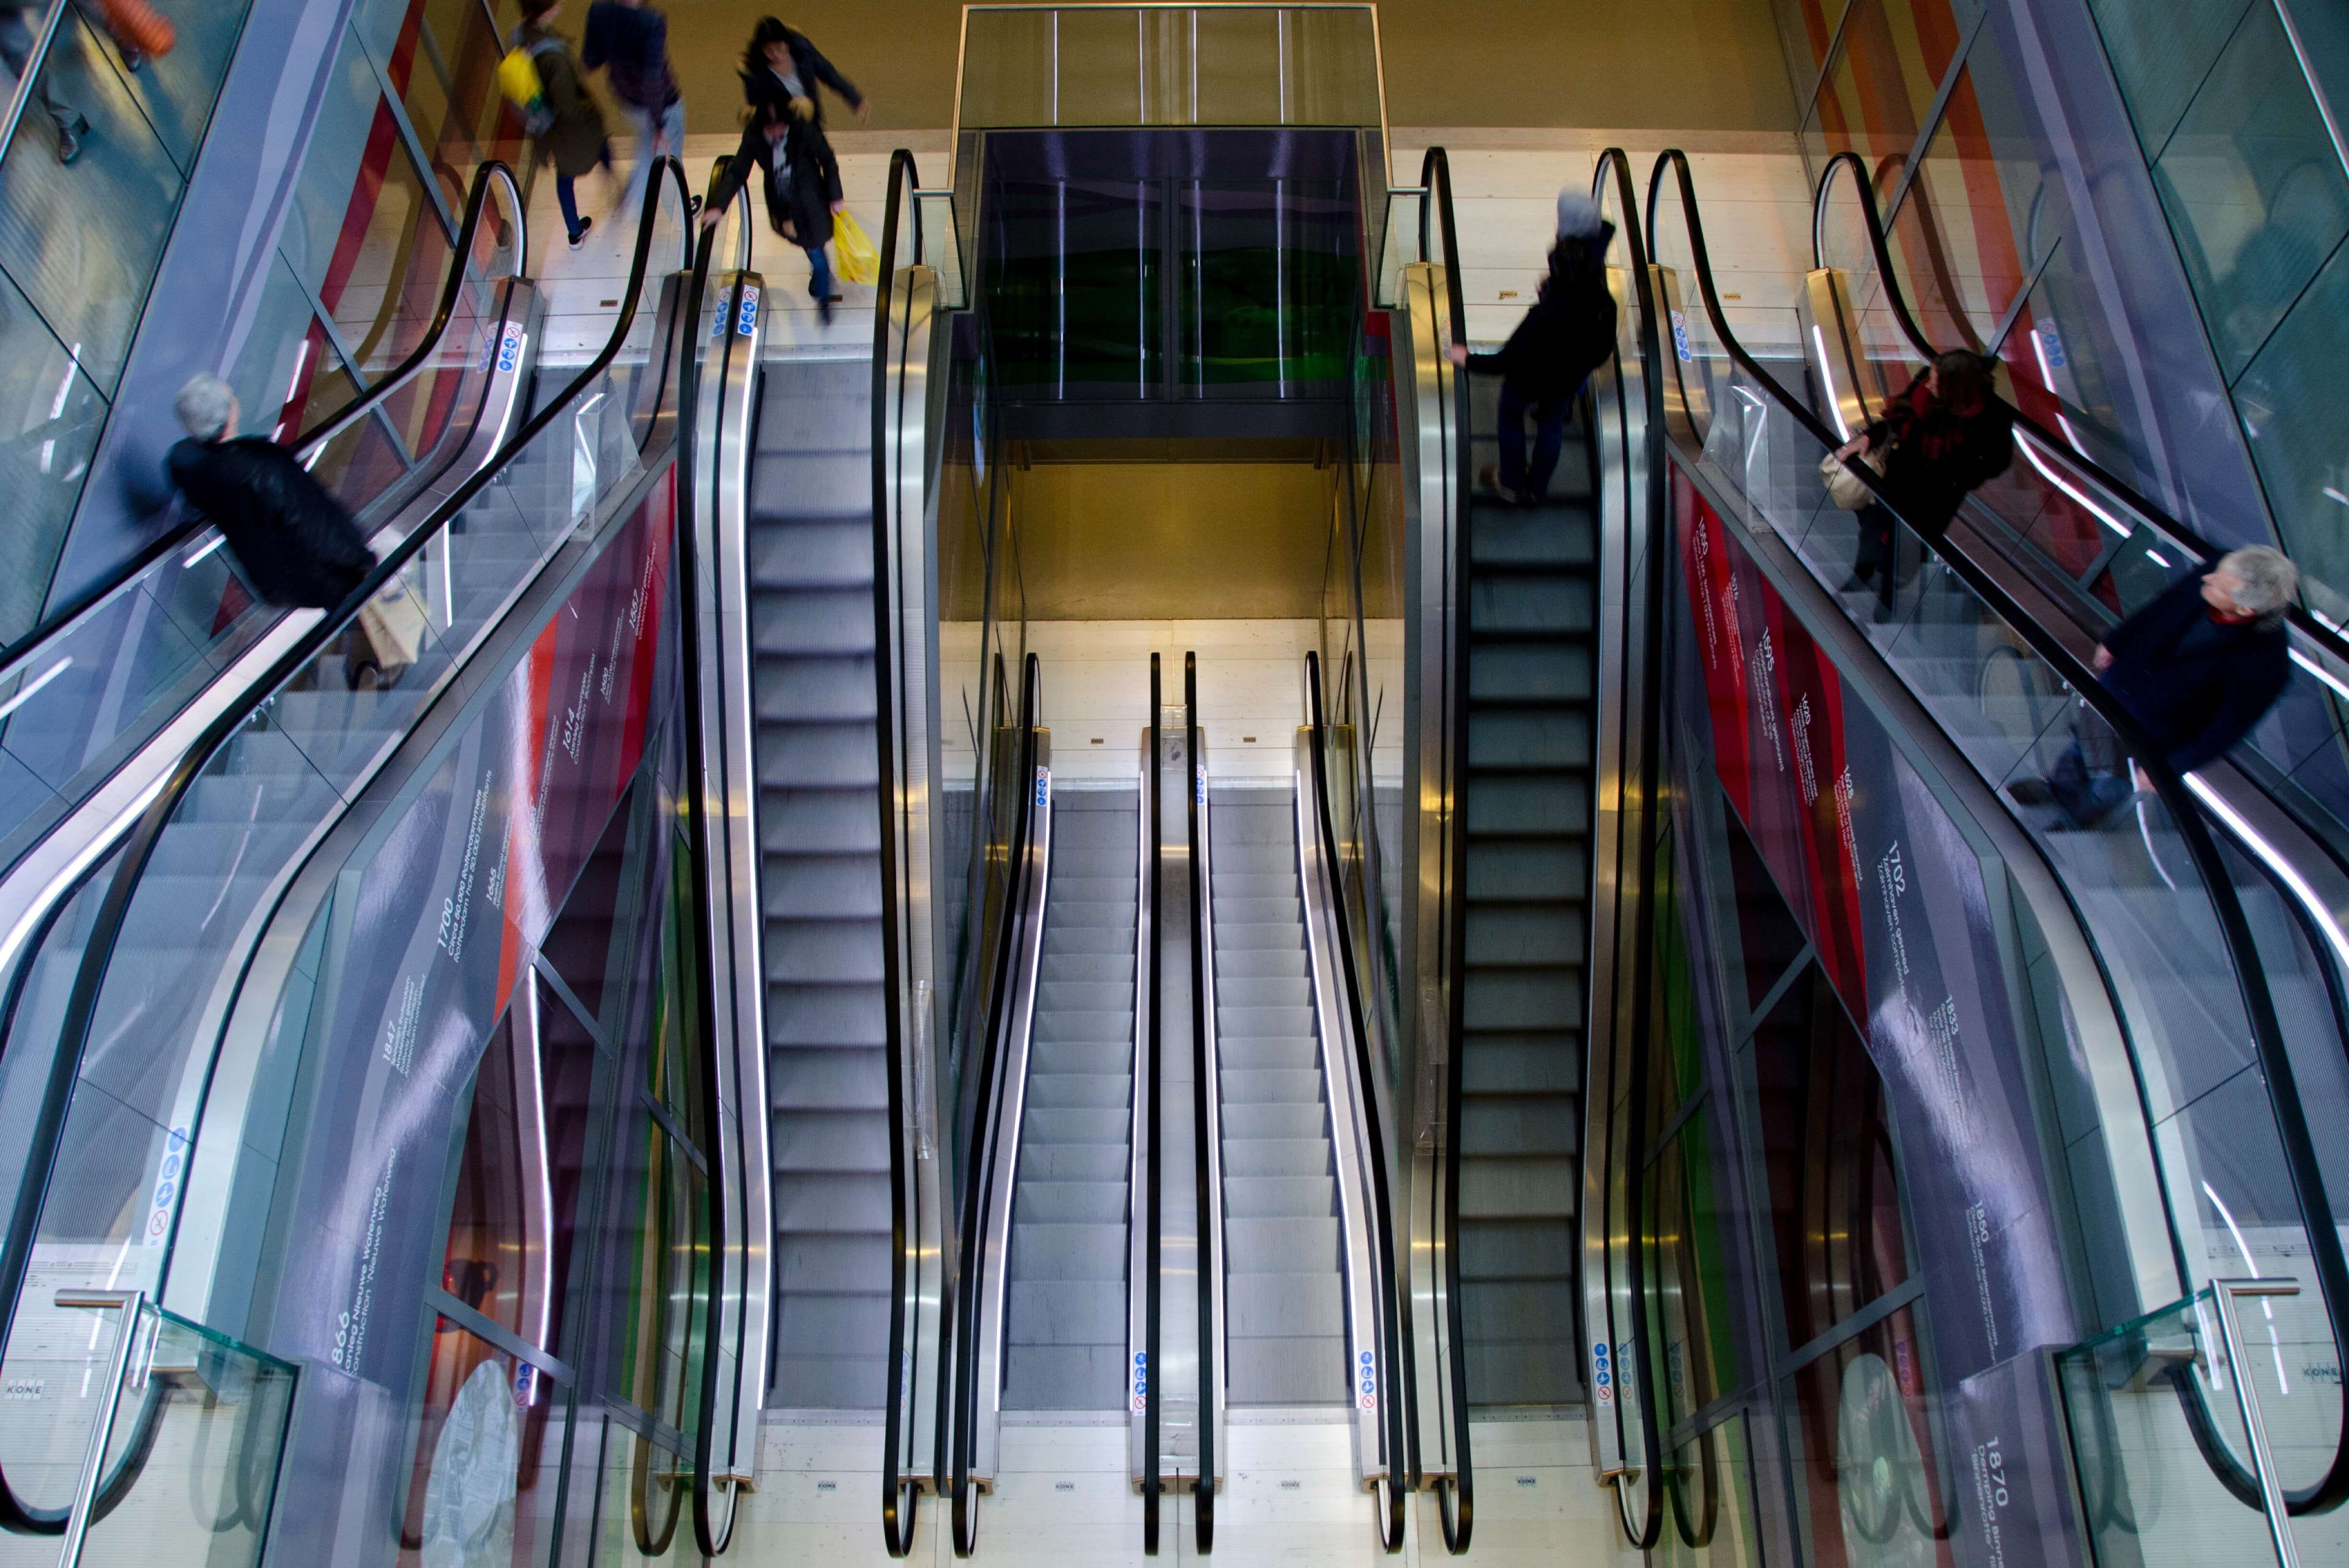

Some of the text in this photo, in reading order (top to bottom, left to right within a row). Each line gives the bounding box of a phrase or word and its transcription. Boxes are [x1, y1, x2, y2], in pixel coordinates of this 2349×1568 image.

[1698, 516, 1709, 555] 1550
[629, 587, 640, 628] 1557
[1761, 626, 1775, 671] 1595
[563, 707, 575, 749] 1614
[1801, 692, 1811, 724] 1620
[1843, 764, 1854, 799] 1628
[448, 788, 481, 956] Circa 50.000 Rotterdammers
[486, 866, 496, 901] 1665
[1888, 839, 1906, 897] 1702
[453, 897, 469, 963] Rotterdam
[469, 834, 480, 872] 50.000
[1883, 855, 1909, 975] Zalmhaven gereed
[438, 897, 453, 948] 1700
[1877, 862, 1907, 1003] Zalmhaven completed
[1945, 994, 1958, 1035] 1833
[383, 1020, 396, 1060] 1847
[1975, 1198, 1988, 1243] 1850
[354, 1263, 368, 1319] Nieuwe
[363, 1184, 382, 1260] Waterweg
[332, 1309, 350, 1365] 866
[2303, 1367, 2338, 1376] KONE
[1976, 1444, 1996, 1522] Demping
[1986, 1435, 2008, 1507] 1870
